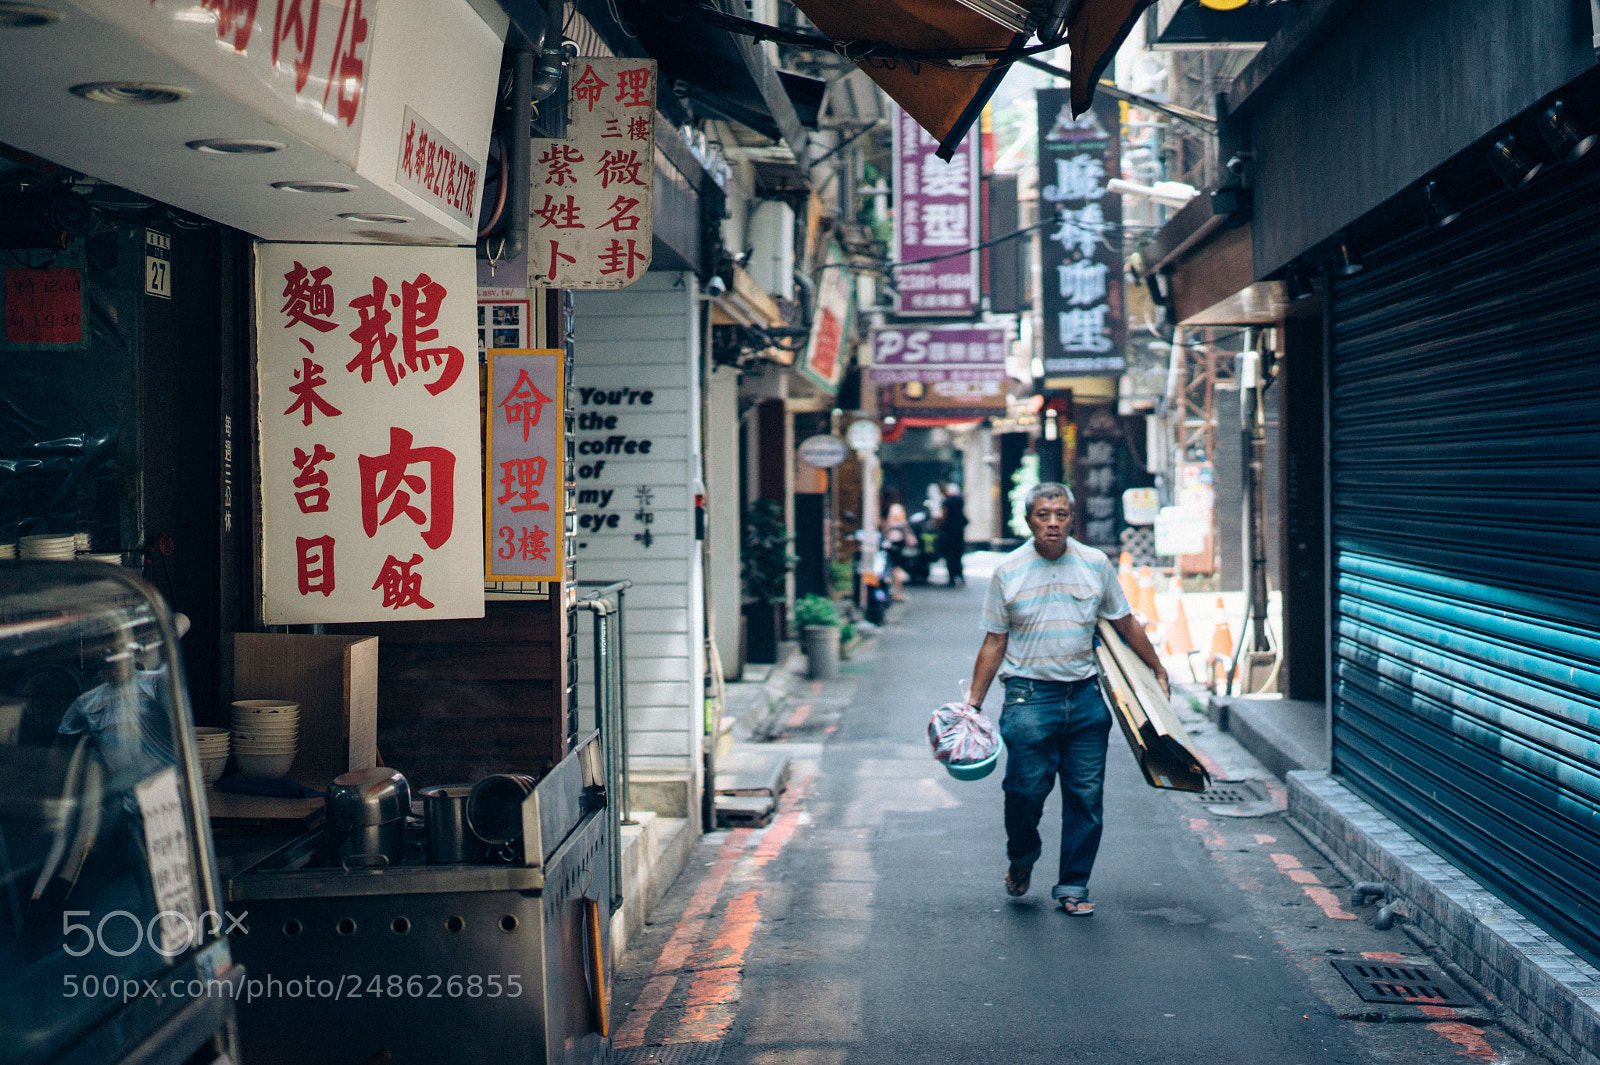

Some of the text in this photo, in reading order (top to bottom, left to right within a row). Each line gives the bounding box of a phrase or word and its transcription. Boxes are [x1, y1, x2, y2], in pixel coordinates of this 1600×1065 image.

[572, 64, 652, 112] 命理
[600, 116, 651, 142] 三樓
[537, 144, 647, 189] 紫微
[533, 194, 642, 233] 姓名
[548, 238, 647, 281] 卜卦
[151, 261, 166, 292] 27
[578, 387, 655, 406] You're
[578, 411, 619, 430] the
[497, 368, 554, 514] 命理
[578, 435, 653, 455] coffee
[578, 460, 606, 479] of
[578, 489, 614, 509] my
[578, 514, 620, 533] eye
[497, 525, 551, 562] 3樓
